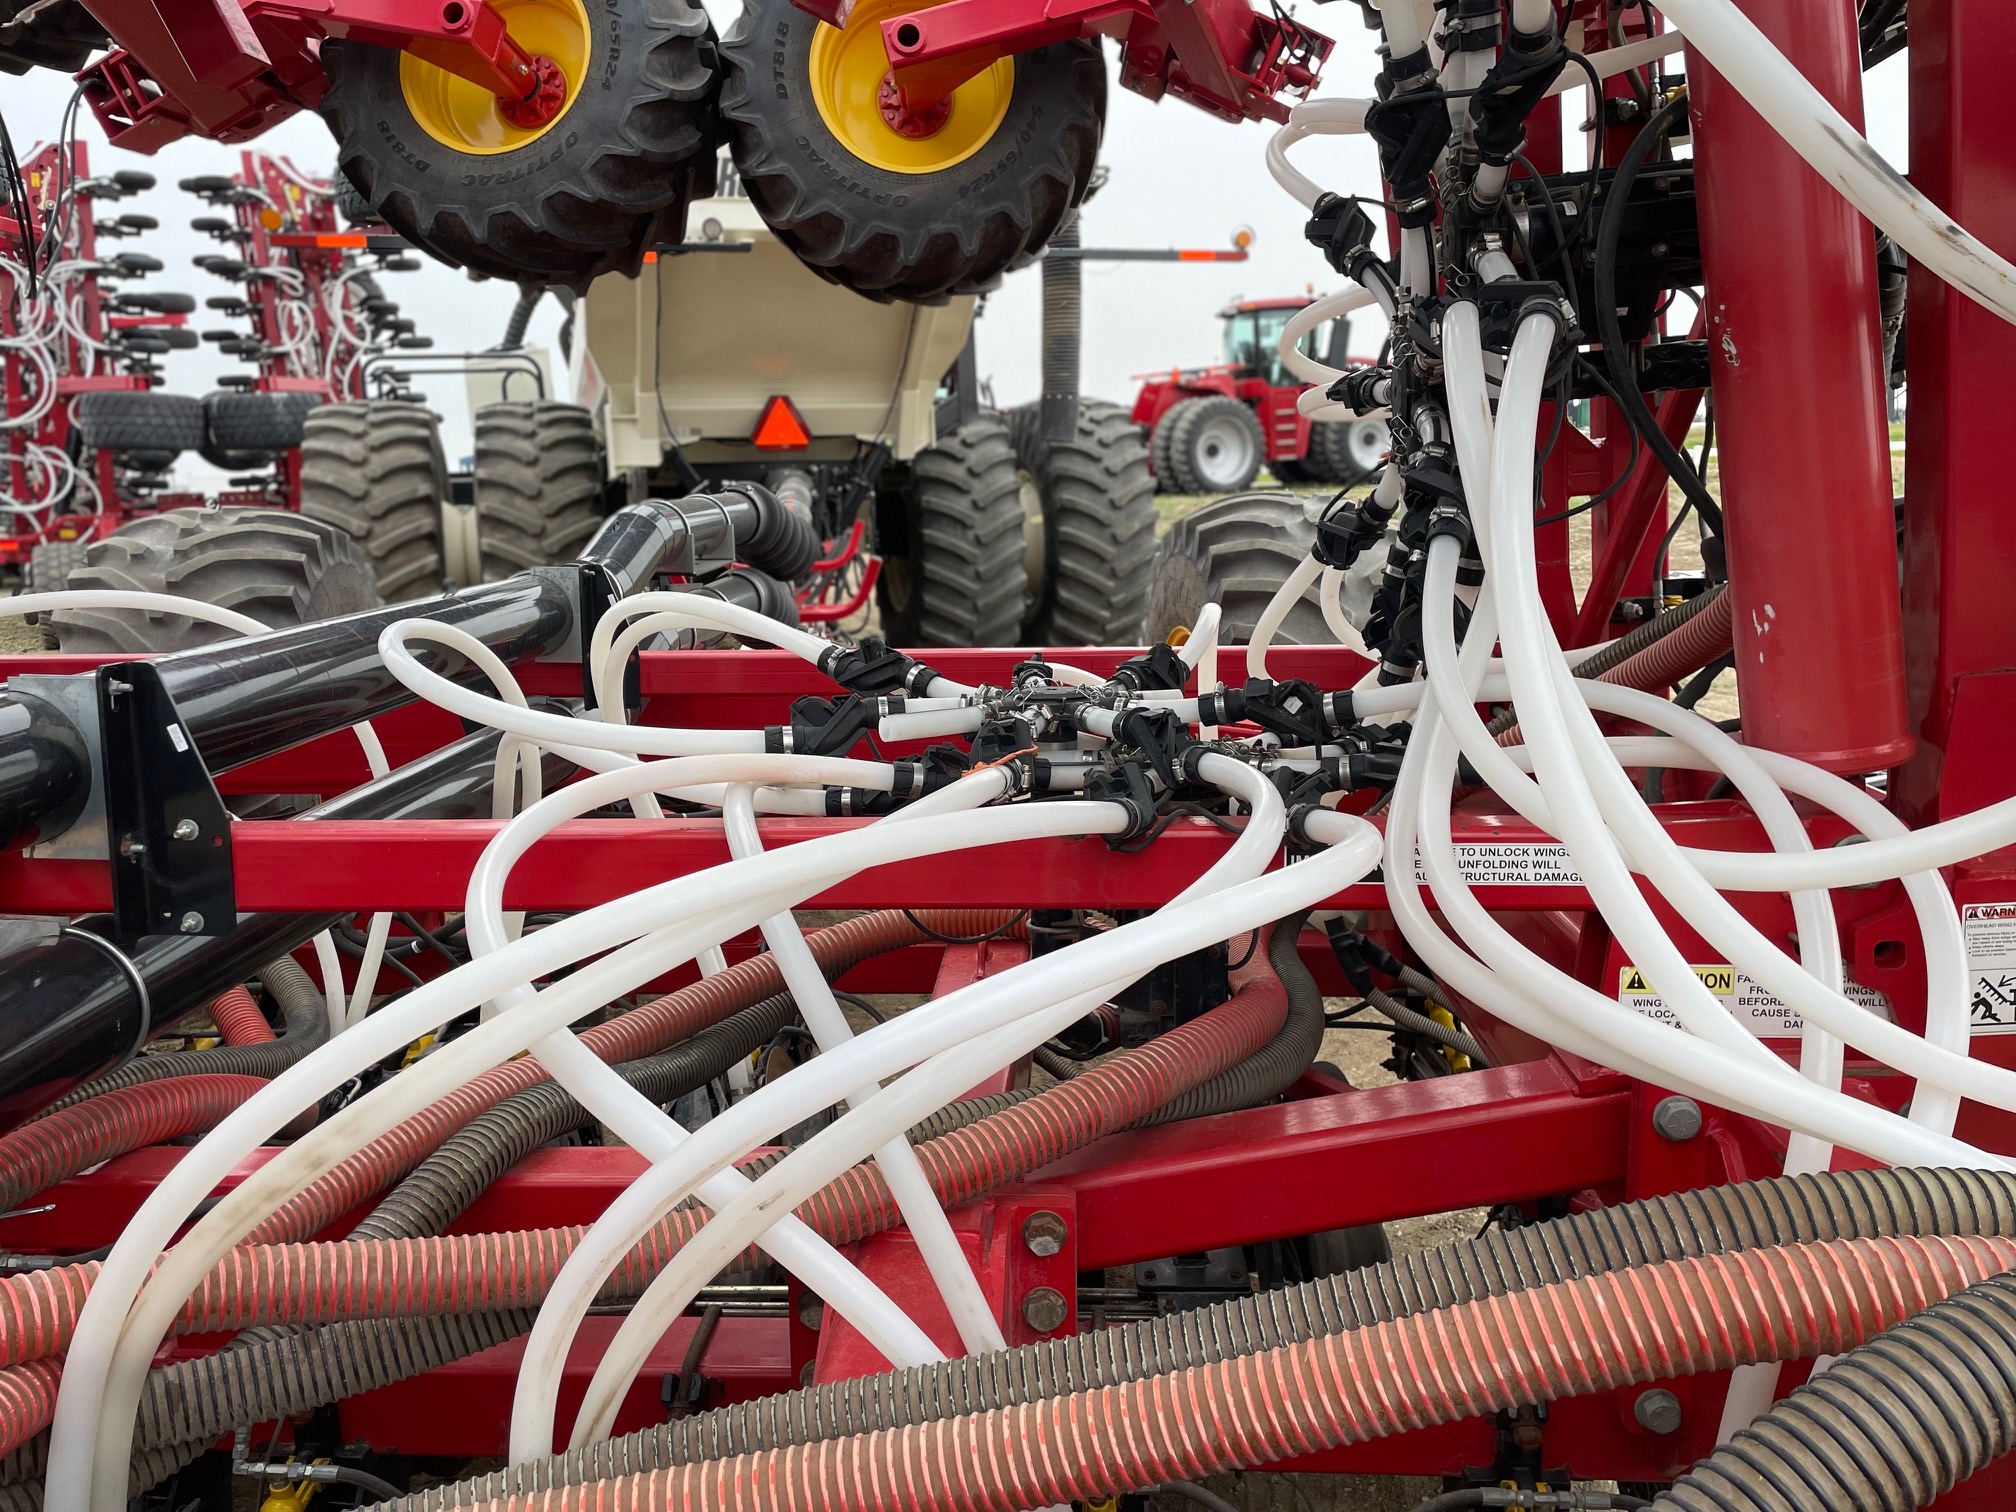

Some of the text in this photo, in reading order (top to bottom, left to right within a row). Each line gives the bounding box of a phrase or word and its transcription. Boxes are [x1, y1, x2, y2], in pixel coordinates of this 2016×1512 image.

[773, 20, 790, 100] DT818
[376, 120, 432, 174] DT818
[461, 131, 579, 187] OPTITRAC
[795, 135, 911, 208] OPTITRAC
[1458, 860, 1561, 869] UNFOLDING WILL
[1460, 848, 1476, 857] TO
[1480, 848, 1530, 857] UNLOCK
[1533, 848, 1570, 857] WING
[1751, 1008, 1791, 1017] CAUSE
[1858, 998, 1885, 1007] WILL
